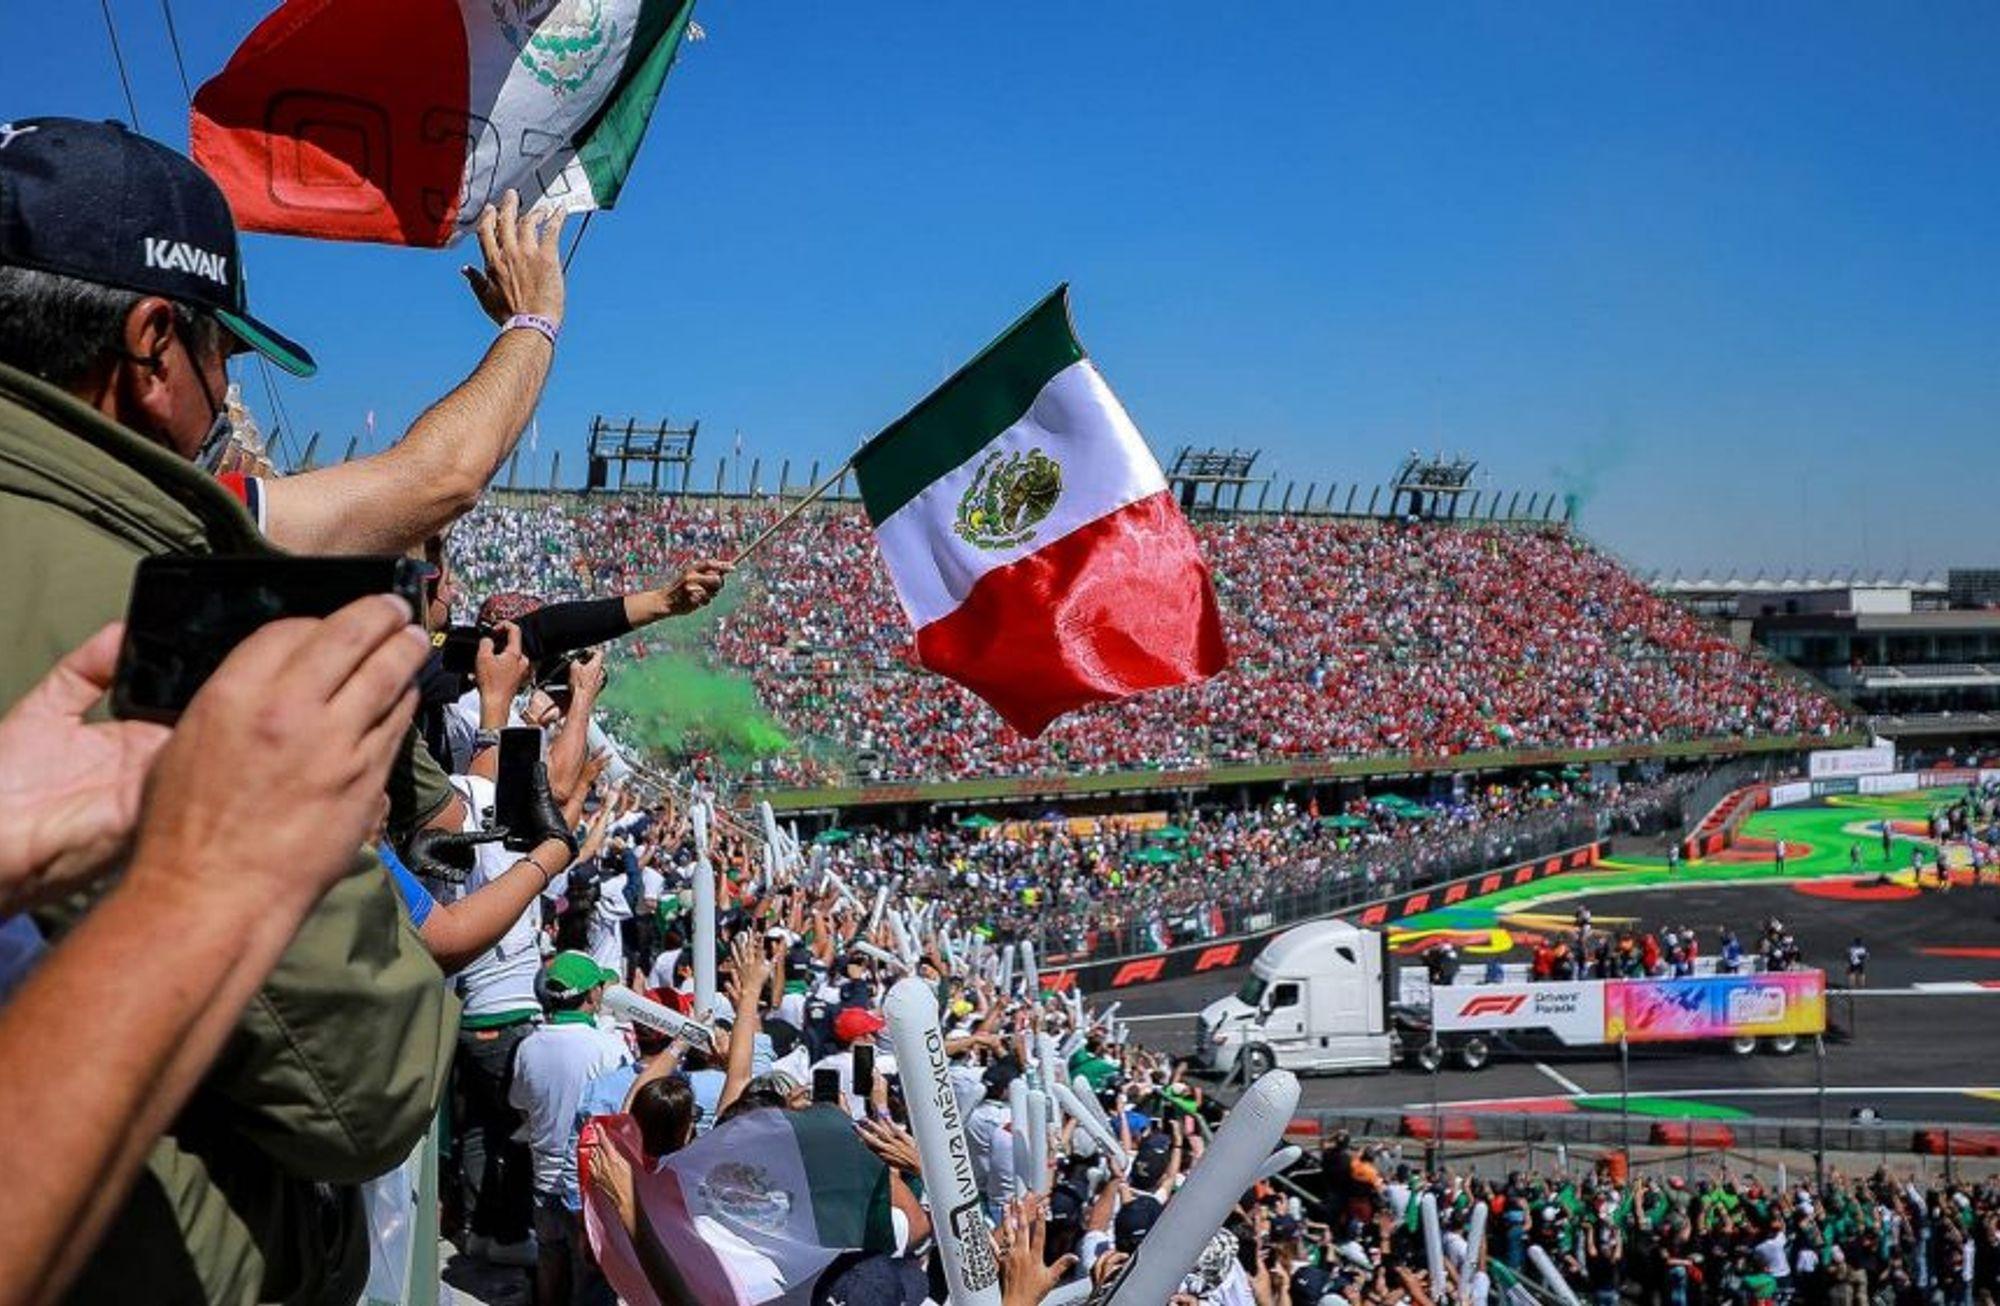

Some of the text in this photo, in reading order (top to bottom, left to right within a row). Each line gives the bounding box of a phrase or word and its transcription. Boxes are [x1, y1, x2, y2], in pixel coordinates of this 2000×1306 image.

[144, 237, 228, 285] KAVAK
[1112, 957, 1166, 987] F1
[1194, 943, 1241, 972] F1
[1459, 994, 1527, 1016] F1
